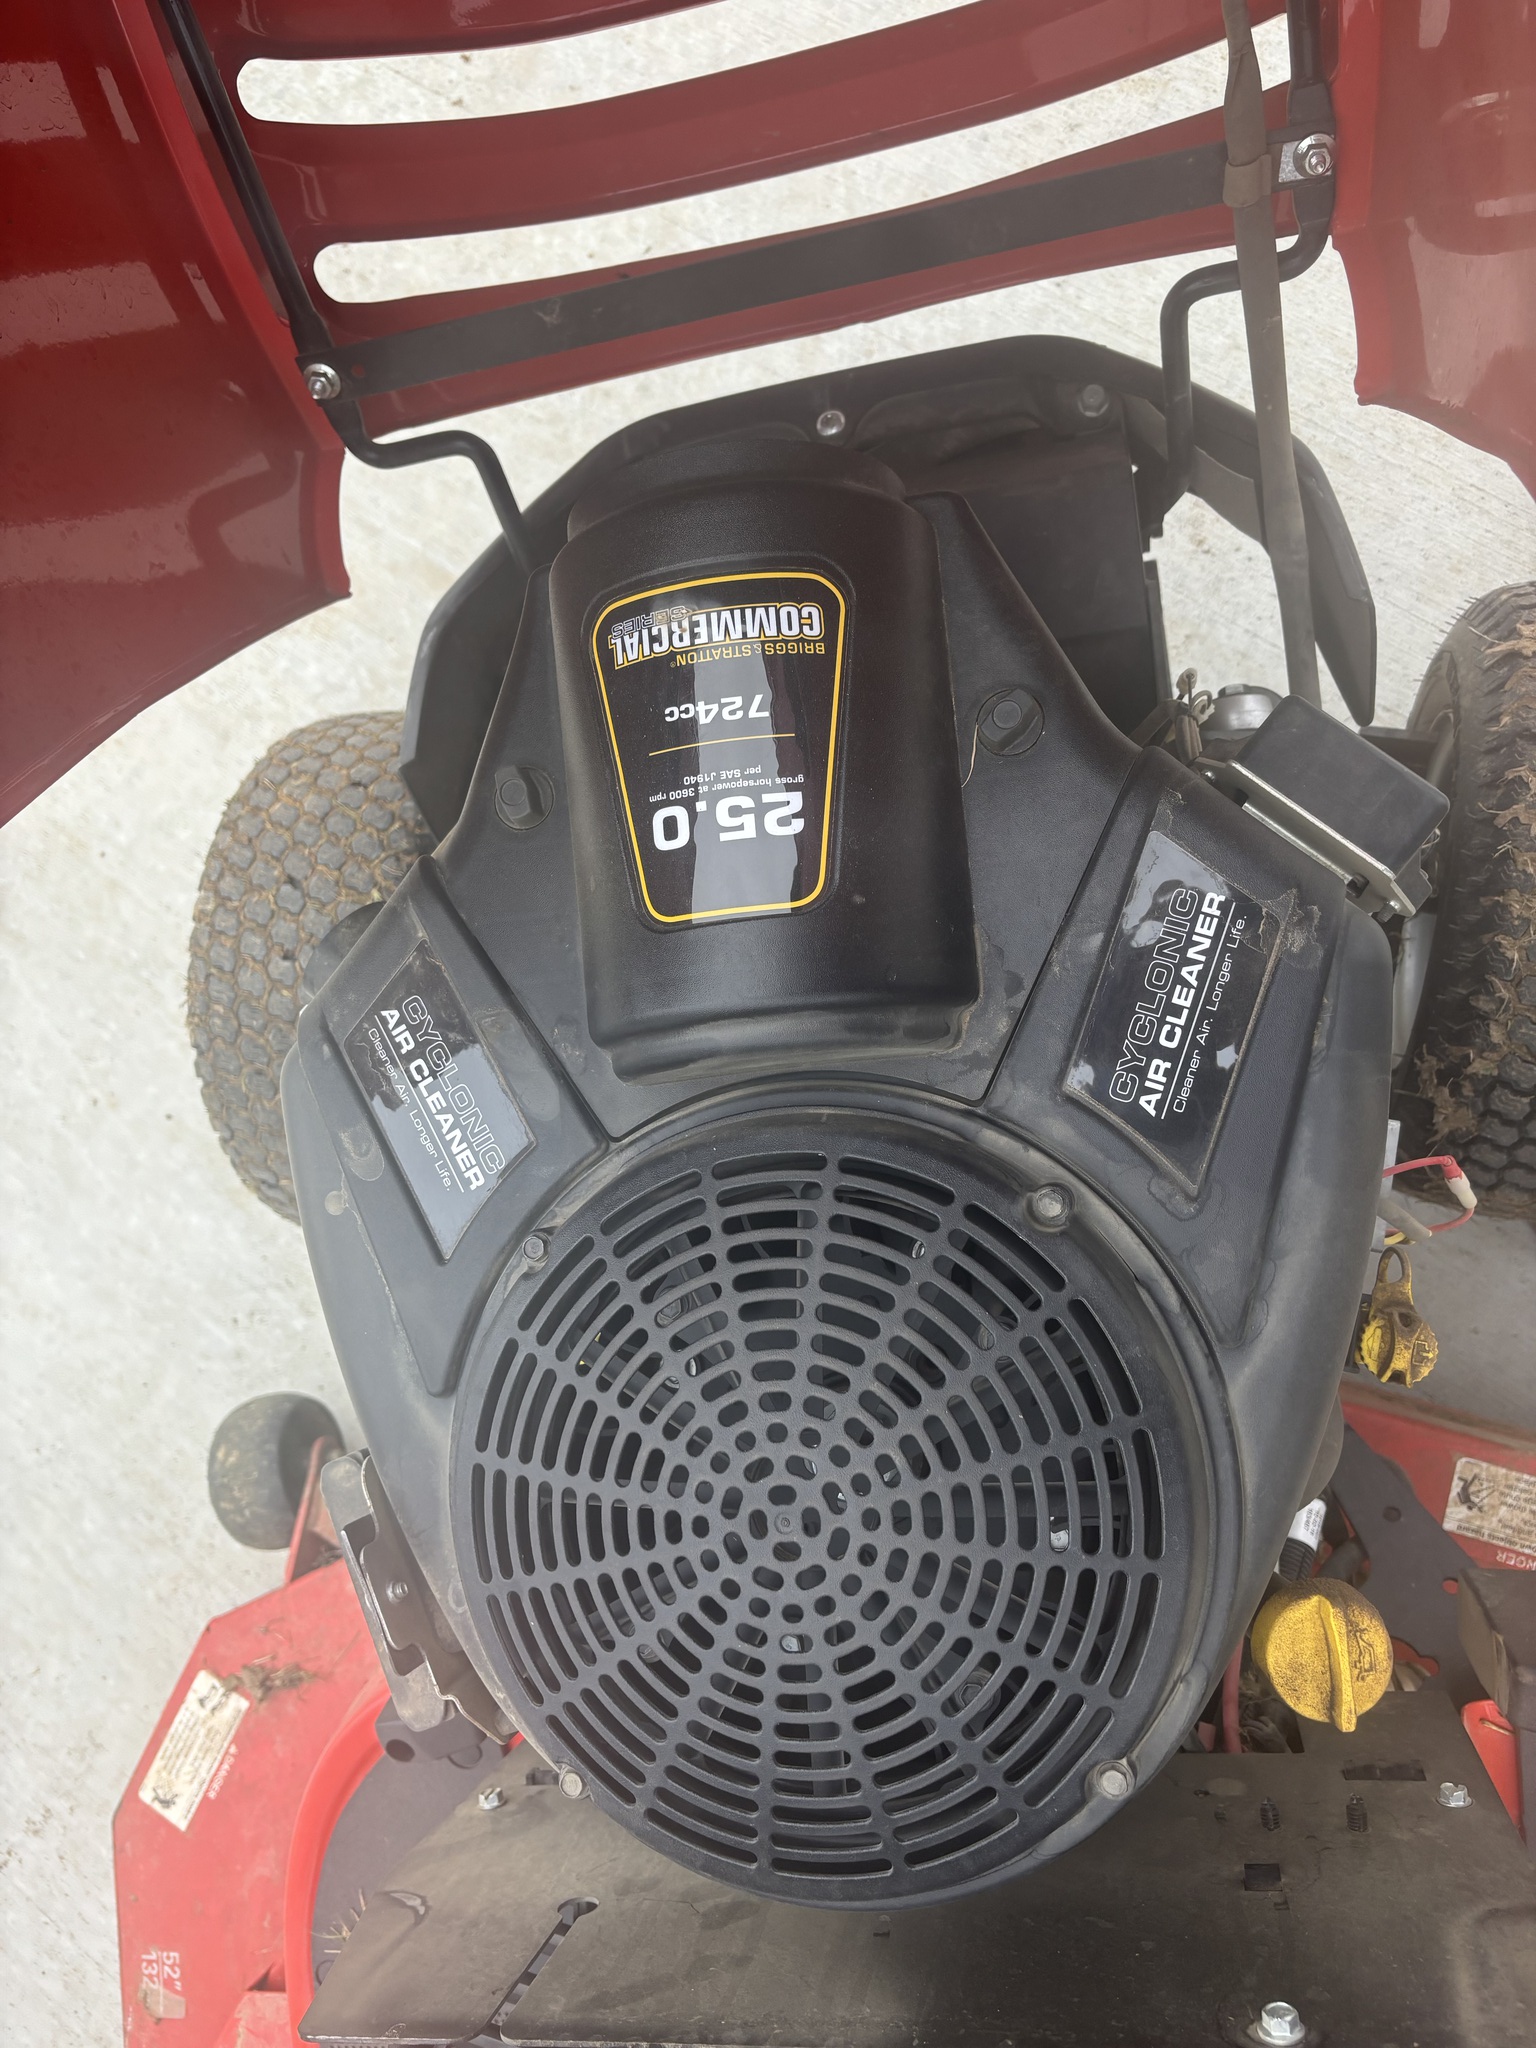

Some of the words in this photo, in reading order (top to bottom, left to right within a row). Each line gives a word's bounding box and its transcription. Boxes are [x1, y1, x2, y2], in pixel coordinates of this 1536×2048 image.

[608, 602, 825, 670] COMMERCIAL
[611, 605, 689, 639] SERIES
[664, 694, 770, 725] 724cc
[683, 771, 717, 785] J1940
[712, 777, 772, 791] horsepower
[719, 769, 741, 780] SAE
[744, 765, 762, 775] per
[775, 774, 804, 784] gross
[649, 793, 667, 803] rpm
[669, 787, 695, 800] 3600
[698, 784, 709, 794] at
[652, 791, 805, 851] 25.0
[1109, 888, 1199, 1103] CYCLONIC
[1138, 1057, 1172, 1118] AIR
[1158, 891, 1226, 1049] CLEANER
[1173, 1049, 1201, 1113] Cleaner
[1196, 1018, 1214, 1046] Air.
[1209, 953, 1235, 1011] Longer
[1229, 915, 1248, 949] Life.
[368, 1028, 398, 1081] Cleaner
[409, 1109, 438, 1159] Longer
[380, 1009, 416, 1054] AIR
[409, 1058, 485, 1191] CLEANER
[402, 995, 505, 1175] CYCLONIC
[206, 1754, 235, 1800] DANGER
[141, 1950, 159, 1990] 132
